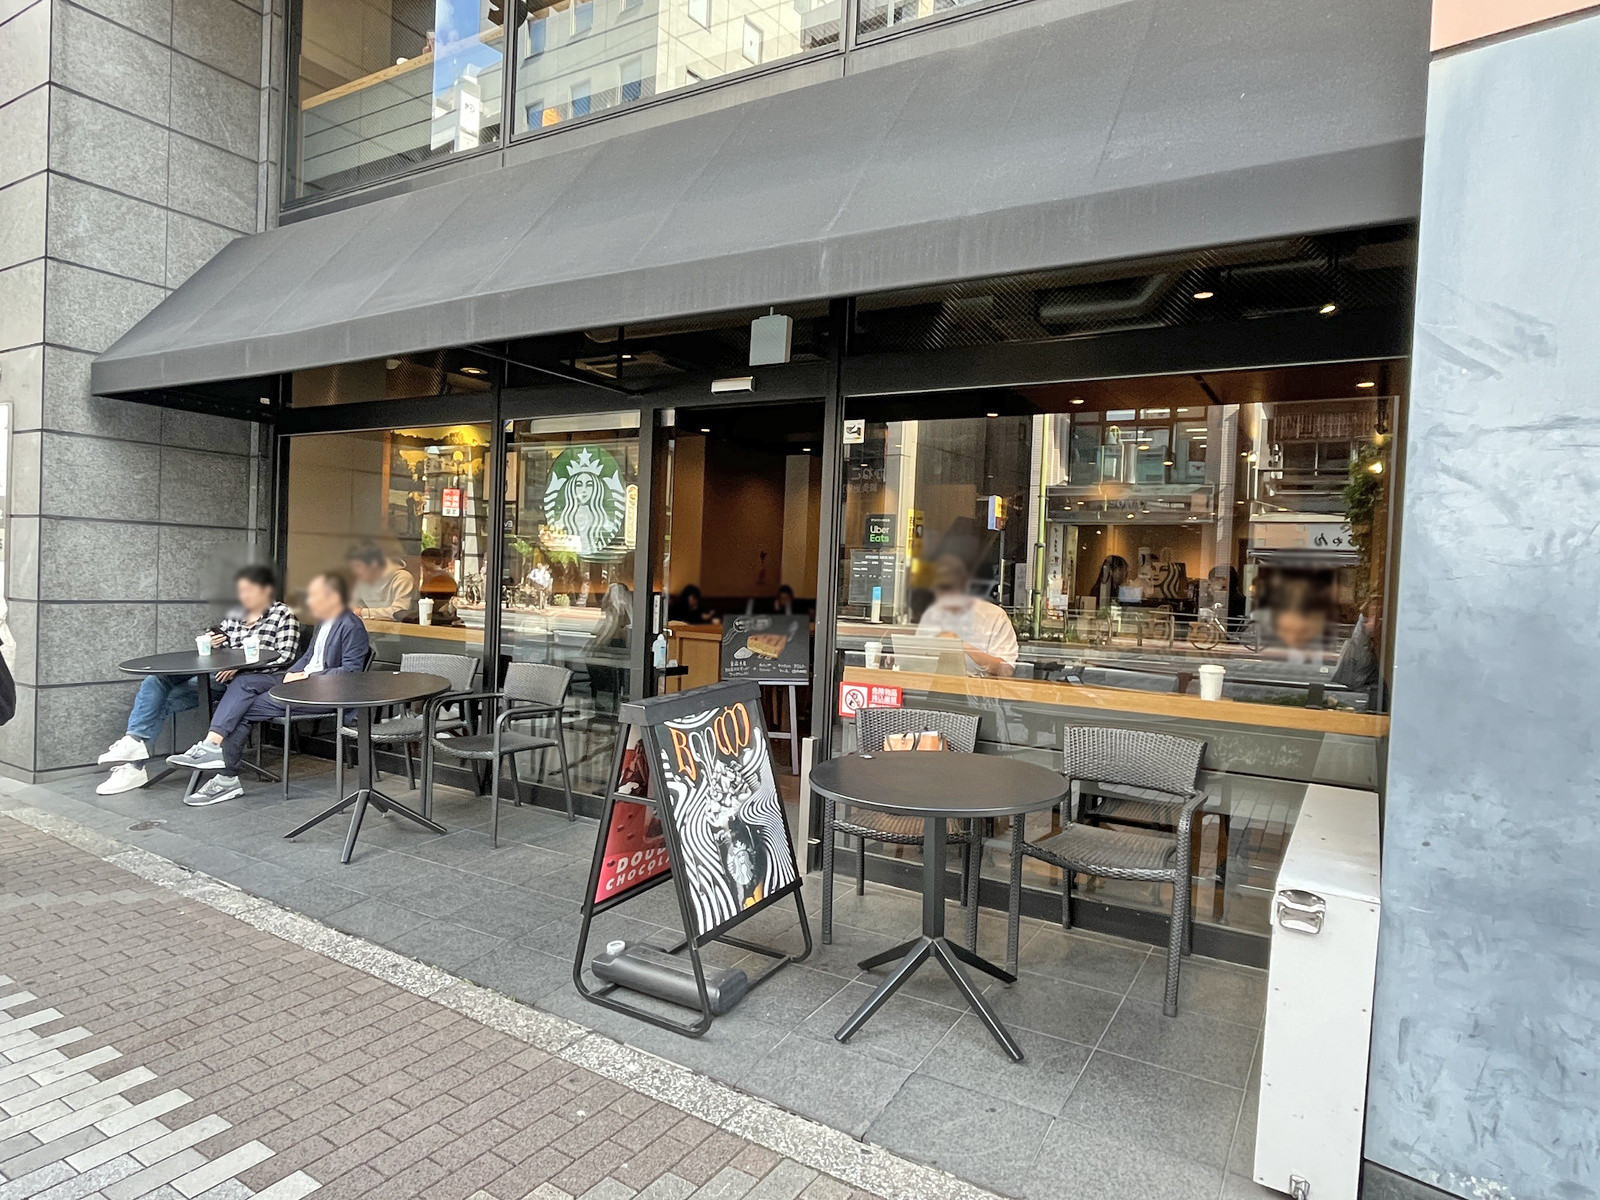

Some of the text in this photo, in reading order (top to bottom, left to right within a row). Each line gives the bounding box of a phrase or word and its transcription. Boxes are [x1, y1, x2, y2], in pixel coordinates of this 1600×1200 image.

[869, 525, 890, 534] Uber
[869, 534, 890, 543] Eats
[605, 856, 670, 891] CHOCOL
